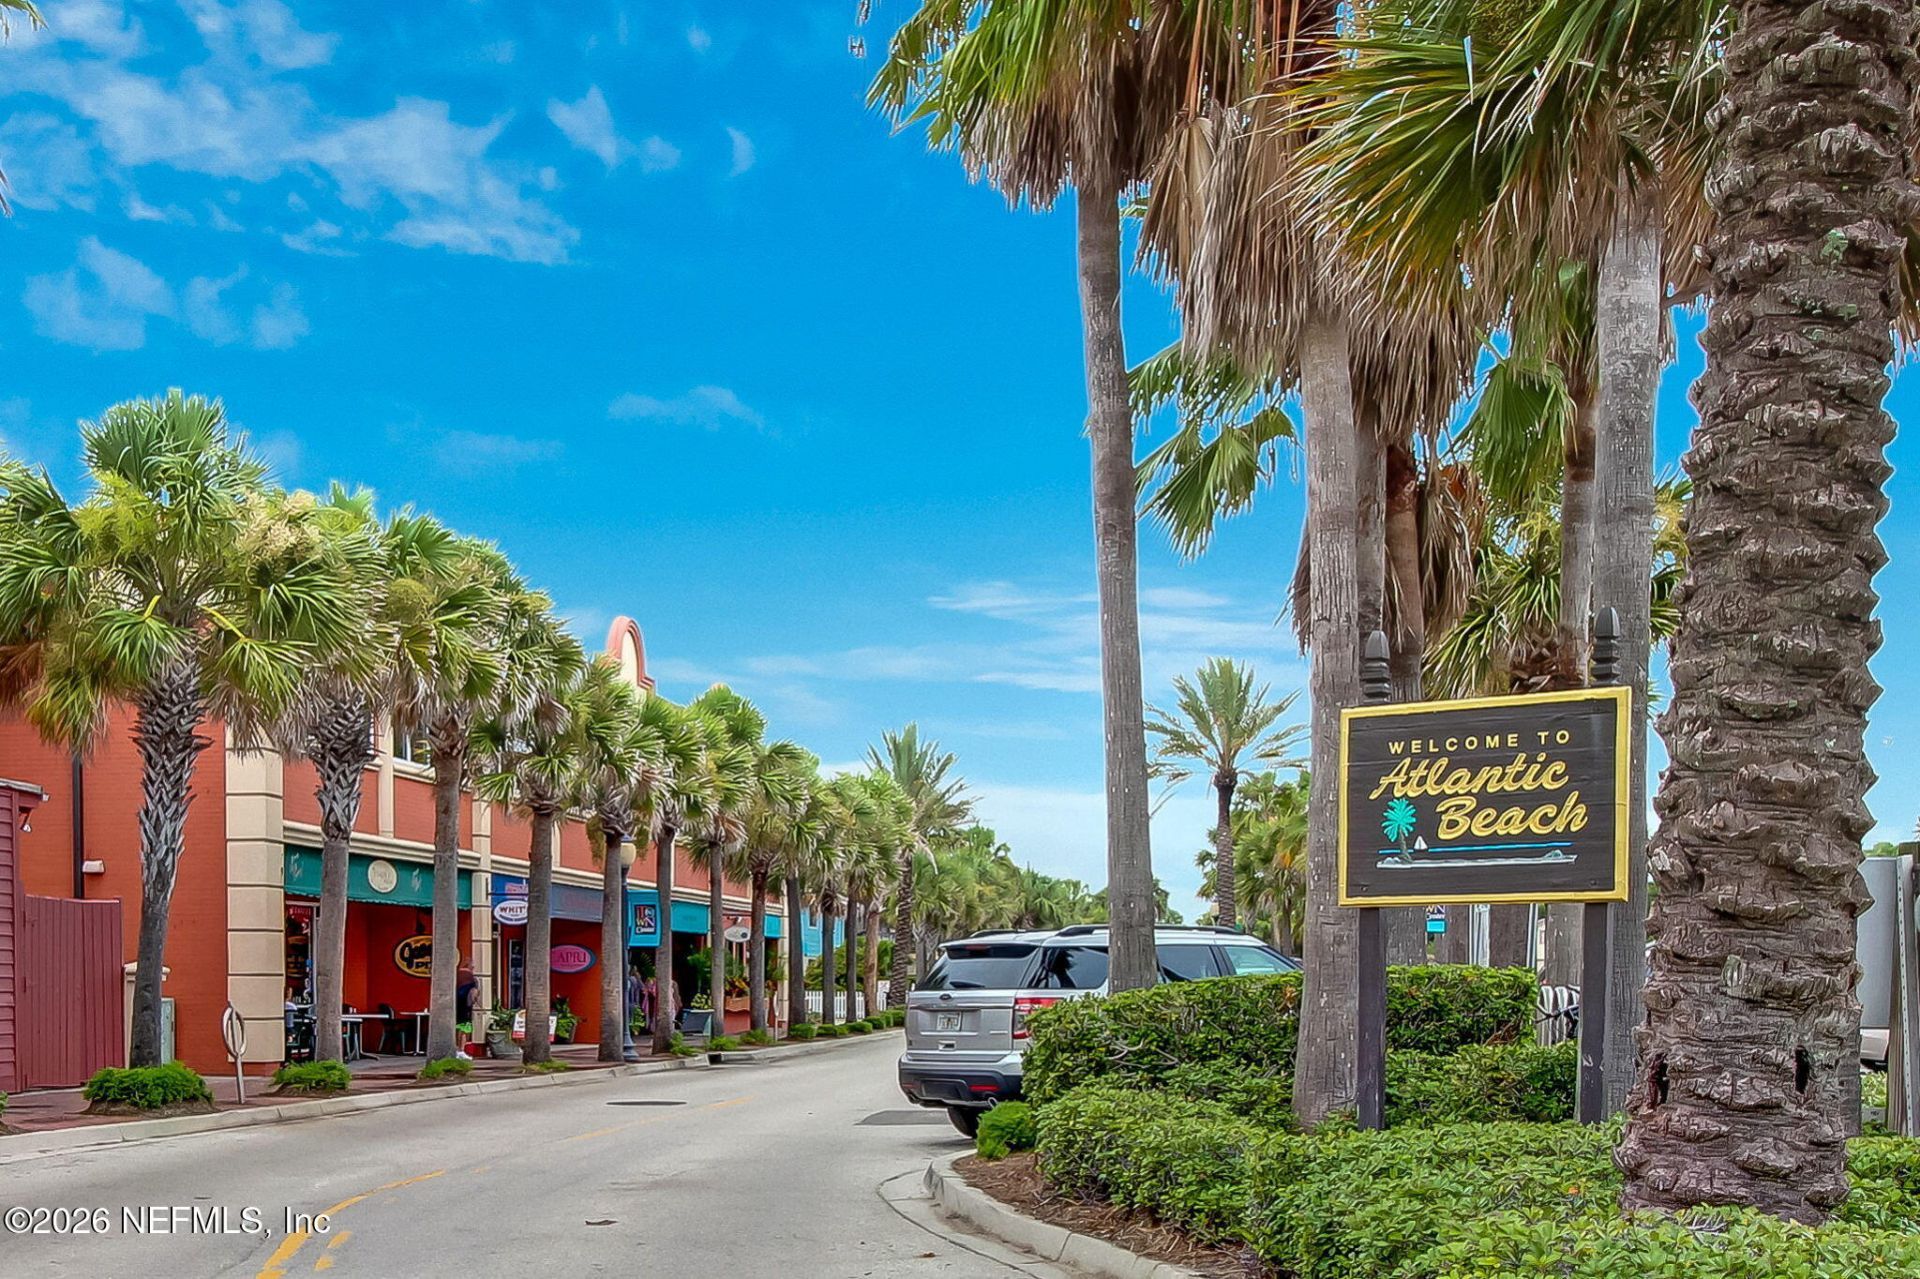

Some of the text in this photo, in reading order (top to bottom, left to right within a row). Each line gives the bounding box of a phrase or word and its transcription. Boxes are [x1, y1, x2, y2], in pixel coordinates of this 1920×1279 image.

[1388, 729, 1571, 754] WELCOME TO
[1368, 751, 1570, 800] Atlantic
[1435, 790, 1588, 841] Beach
